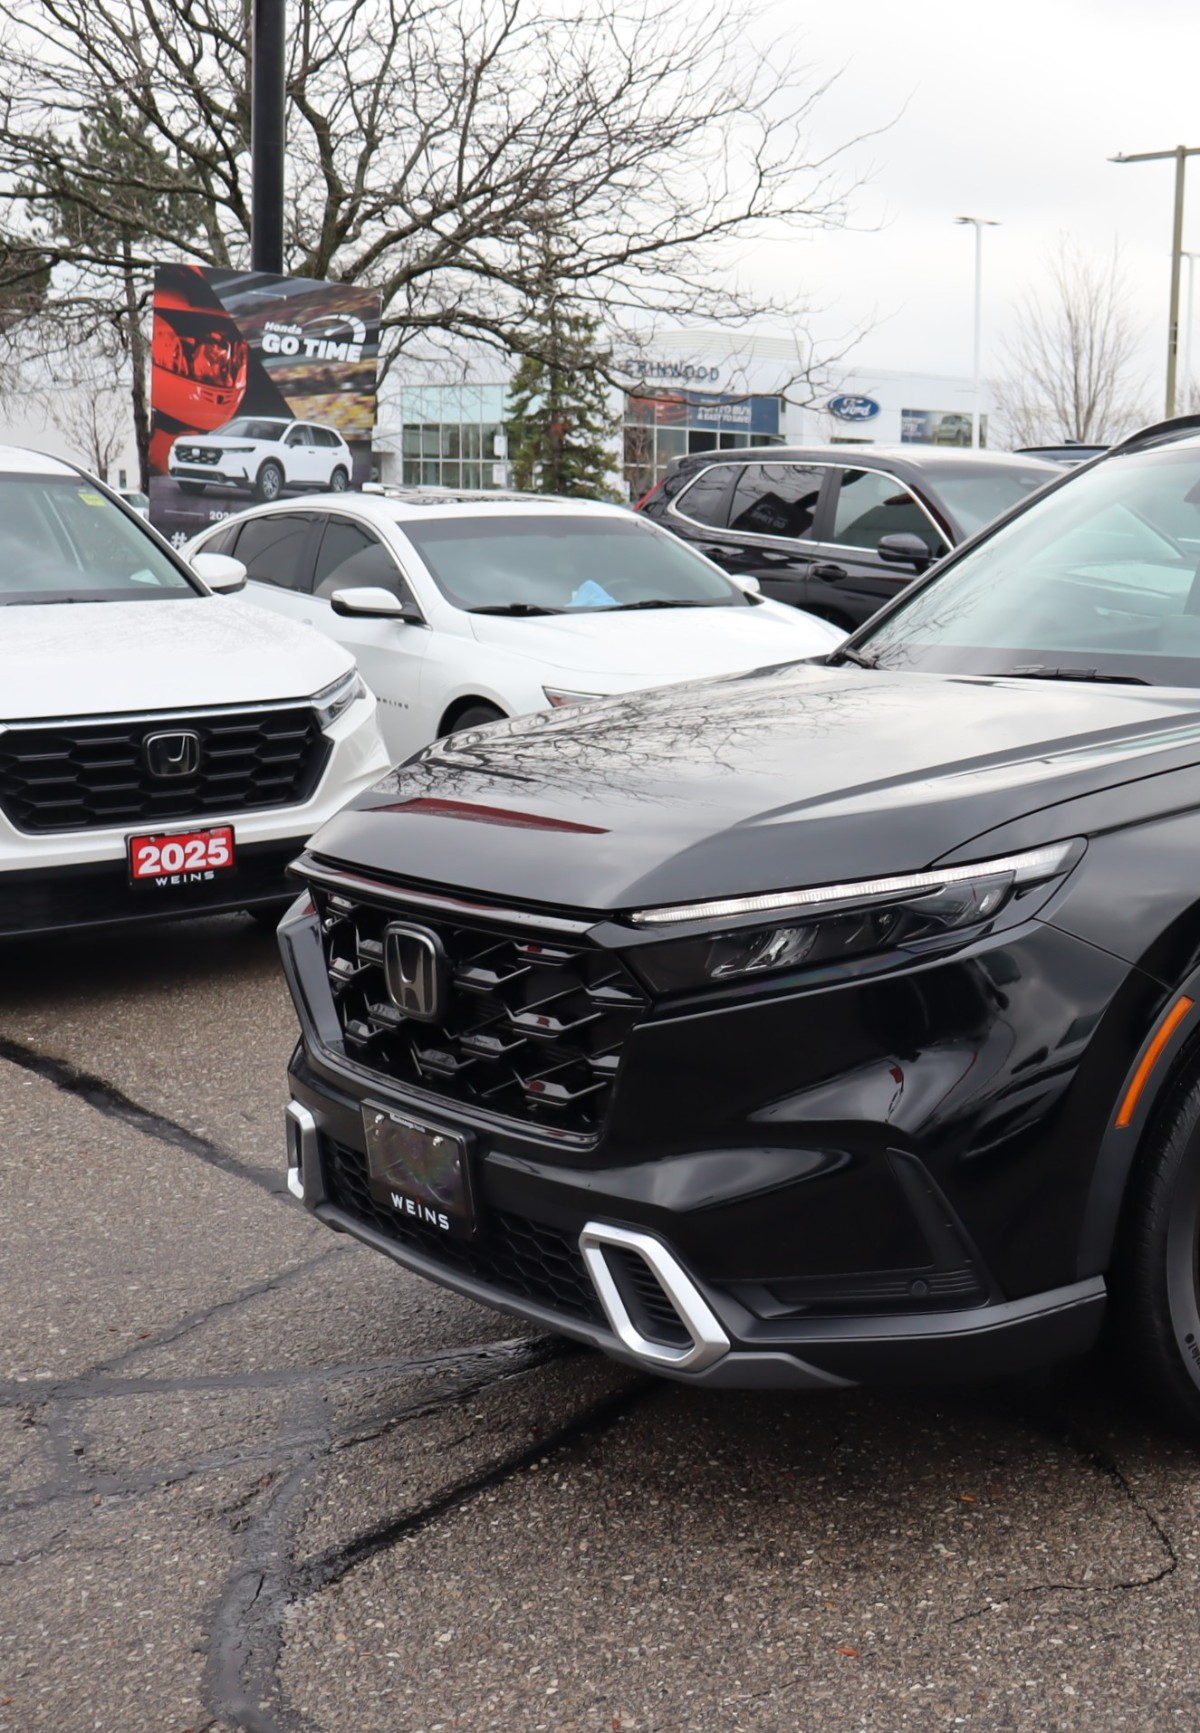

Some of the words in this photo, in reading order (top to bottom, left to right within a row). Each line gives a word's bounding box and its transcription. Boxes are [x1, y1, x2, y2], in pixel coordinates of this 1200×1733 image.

[264, 321, 303, 335] Honda
[261, 333, 300, 356] GO
[303, 338, 363, 363] TIME
[840, 398, 871, 416] Ford
[138, 837, 230, 875] 2025
[155, 870, 215, 887] WEINS
[390, 1191, 451, 1231] WEINS
